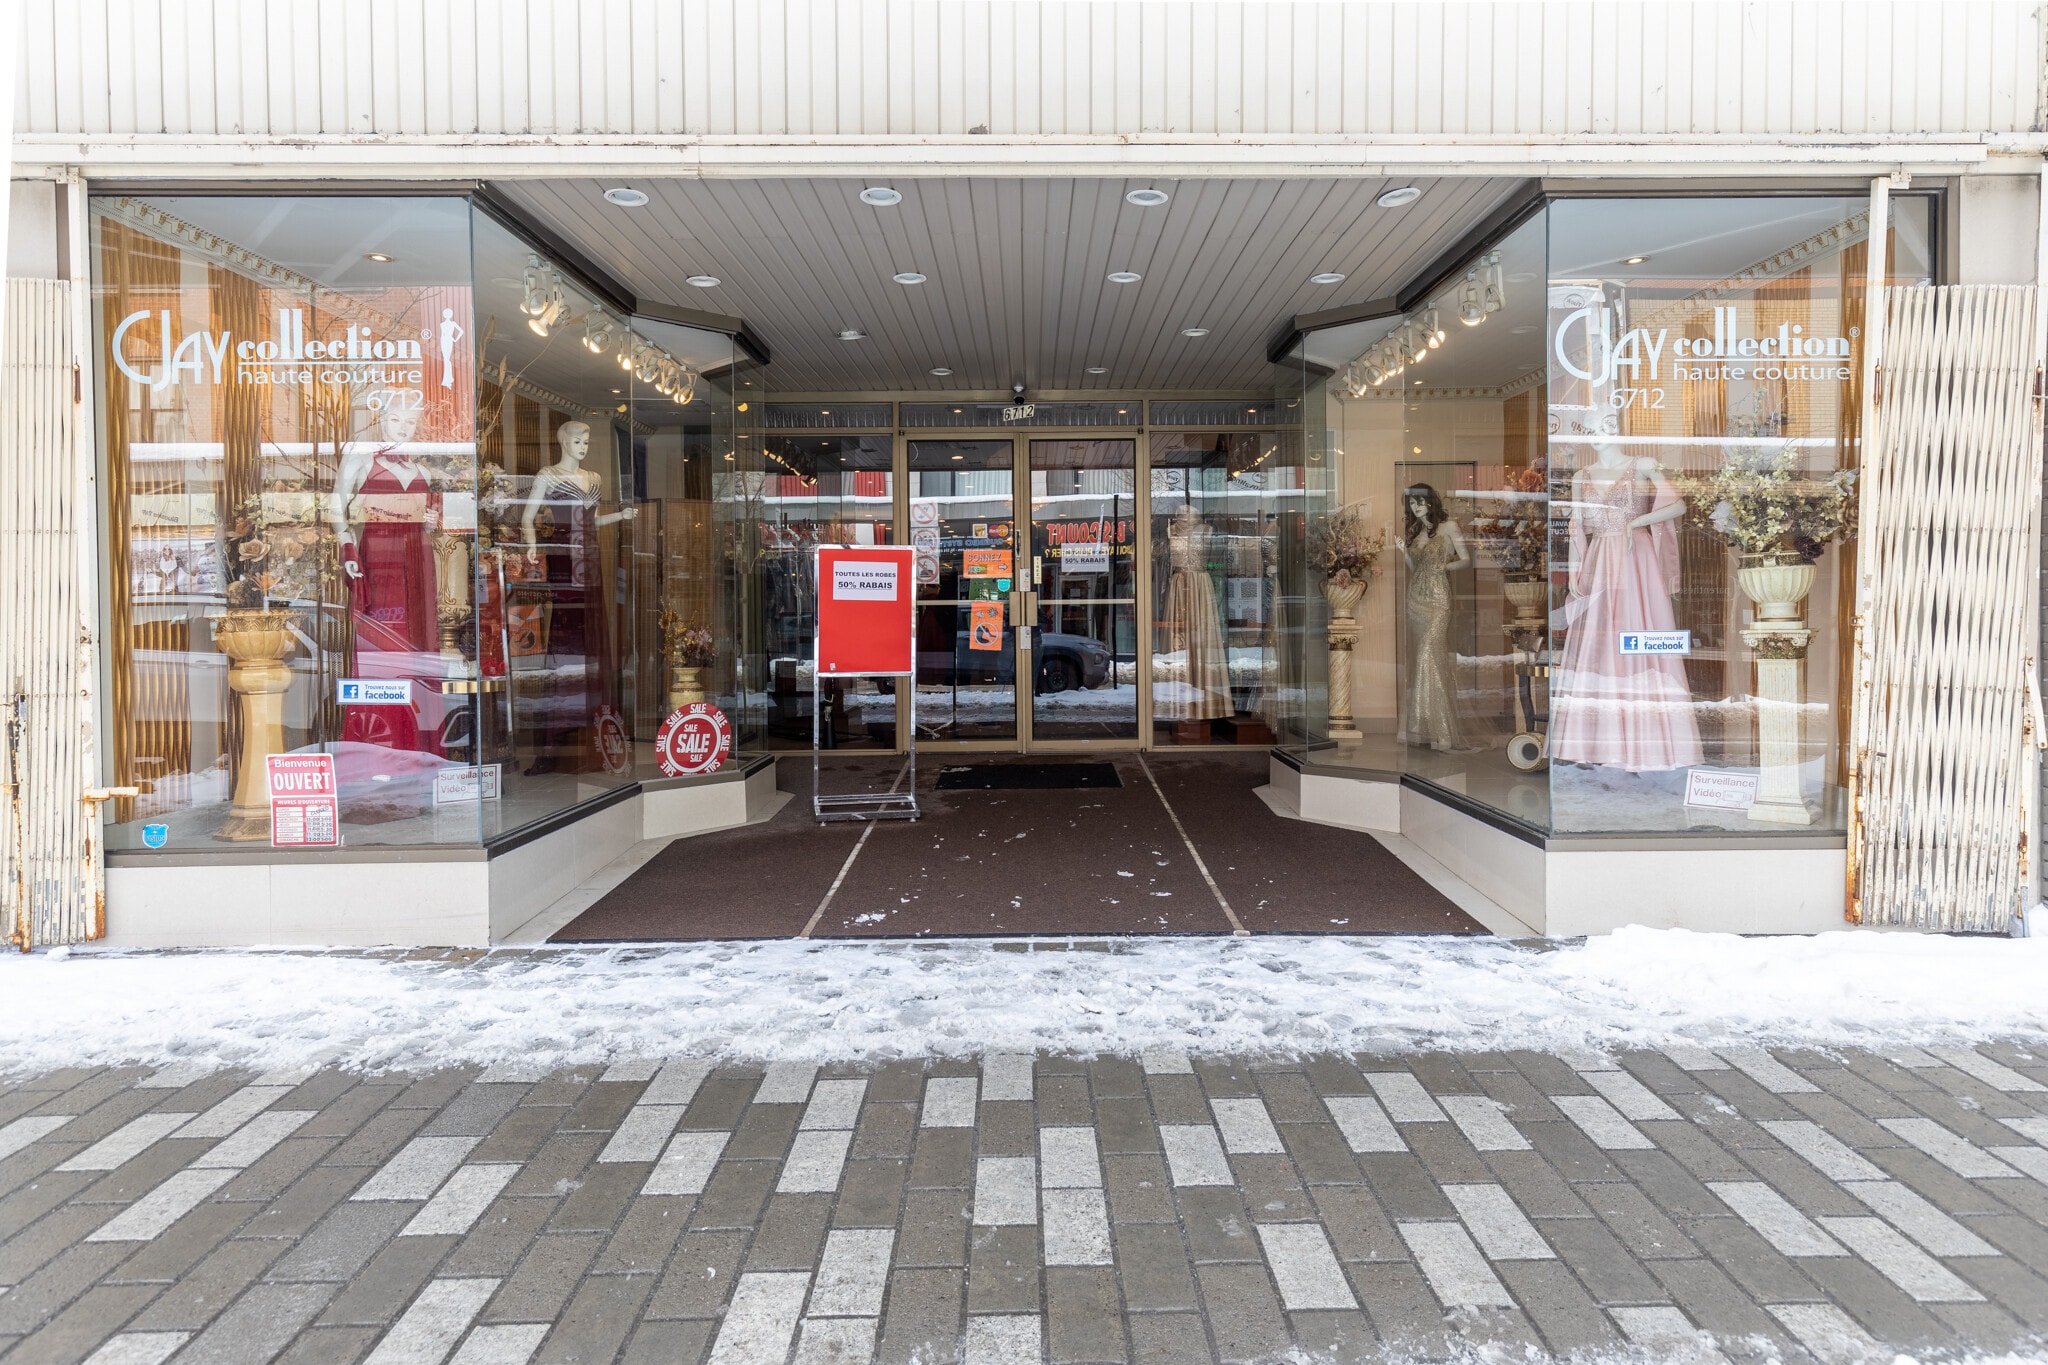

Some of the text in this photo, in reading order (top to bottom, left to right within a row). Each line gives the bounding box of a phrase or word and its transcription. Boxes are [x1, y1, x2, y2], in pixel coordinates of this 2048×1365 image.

[238, 367, 423, 385] haute couture
[1674, 364, 1851, 381] haute couture
[366, 390, 424, 412] 6712
[1609, 388, 1665, 410] 6712
[1004, 406, 1034, 420] 6712
[968, 554, 1002, 562] SONNEZ
[1644, 642, 1683, 650] facebook
[365, 690, 405, 699] facebook
[690, 703, 707, 713] SALE
[666, 709, 683, 727] SALE
[712, 710, 728, 728] SALE
[683, 724, 698, 732] SALE
[656, 734, 667, 752] SALE
[676, 733, 710, 753] SALE
[720, 735, 731, 752] SALE
[274, 759, 327, 768] Bienvenue
[690, 754, 703, 762] SALE
[660, 760, 676, 778] SALE
[273, 772, 330, 790] OUVERT
[441, 784, 466, 793] Vidéo
[1694, 775, 1755, 788] Surveillance
[1693, 788, 1722, 798] Vidéo
